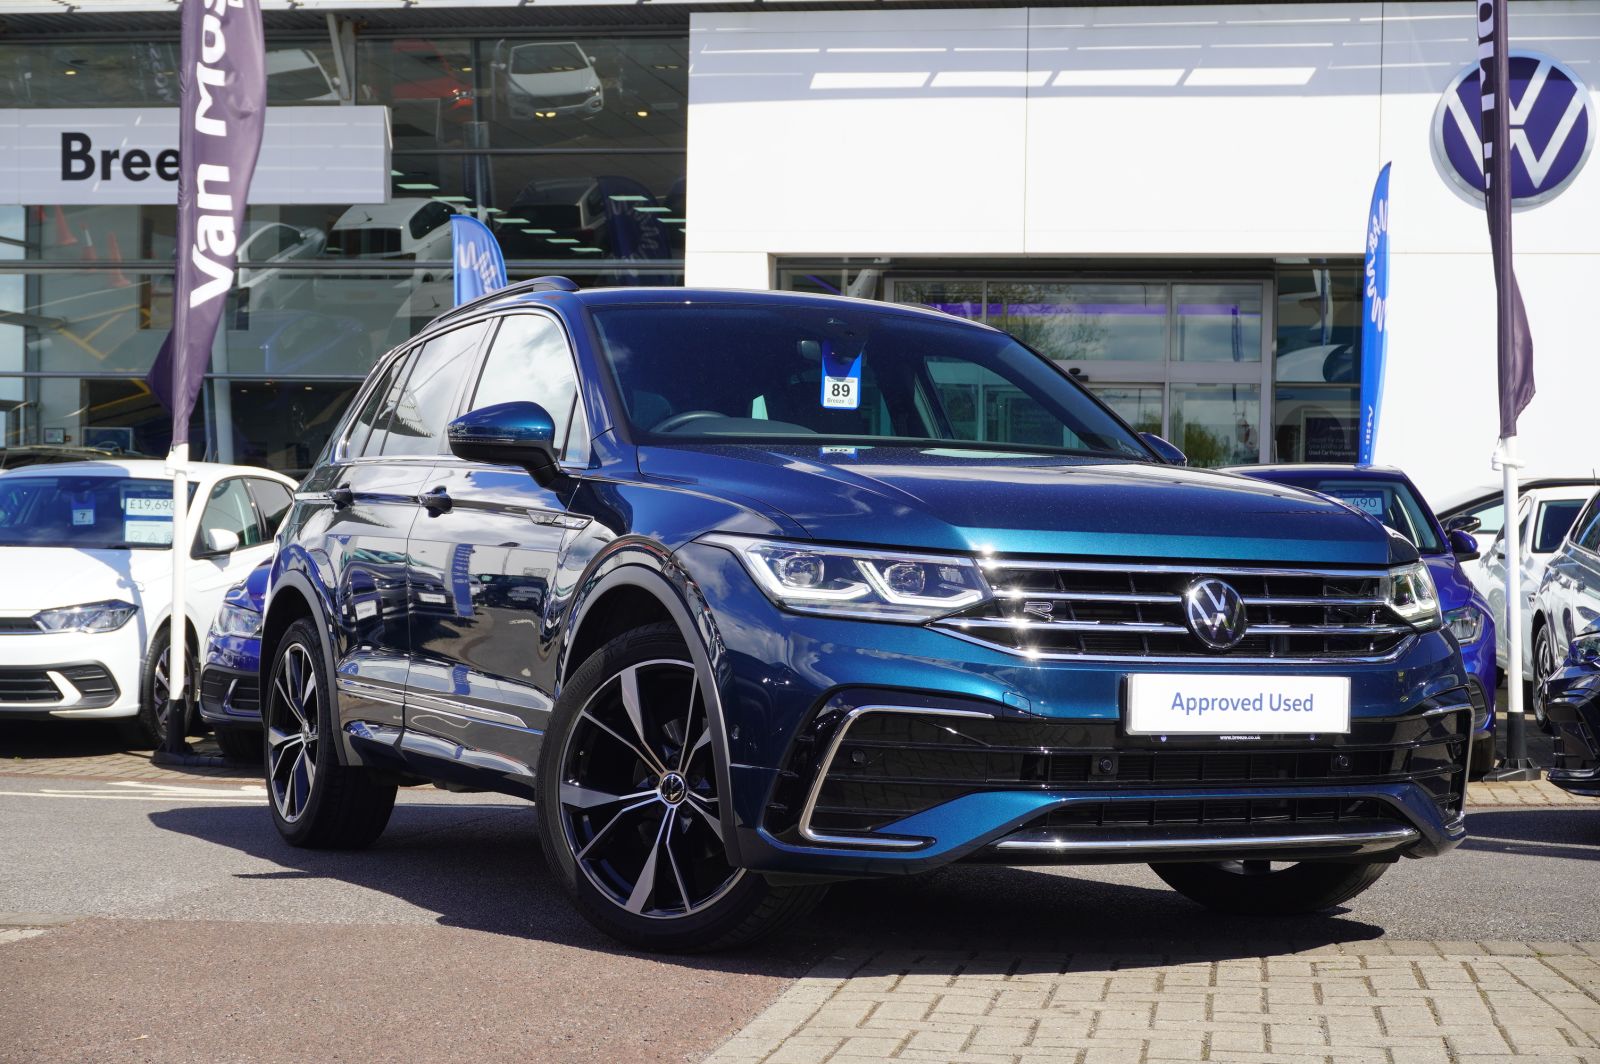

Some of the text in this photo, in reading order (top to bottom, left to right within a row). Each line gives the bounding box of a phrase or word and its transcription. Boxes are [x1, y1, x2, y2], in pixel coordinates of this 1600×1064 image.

[190, 164, 236, 308] Van
[831, 383, 851, 398] 89
[1171, 691, 1314, 716] Approved Used
